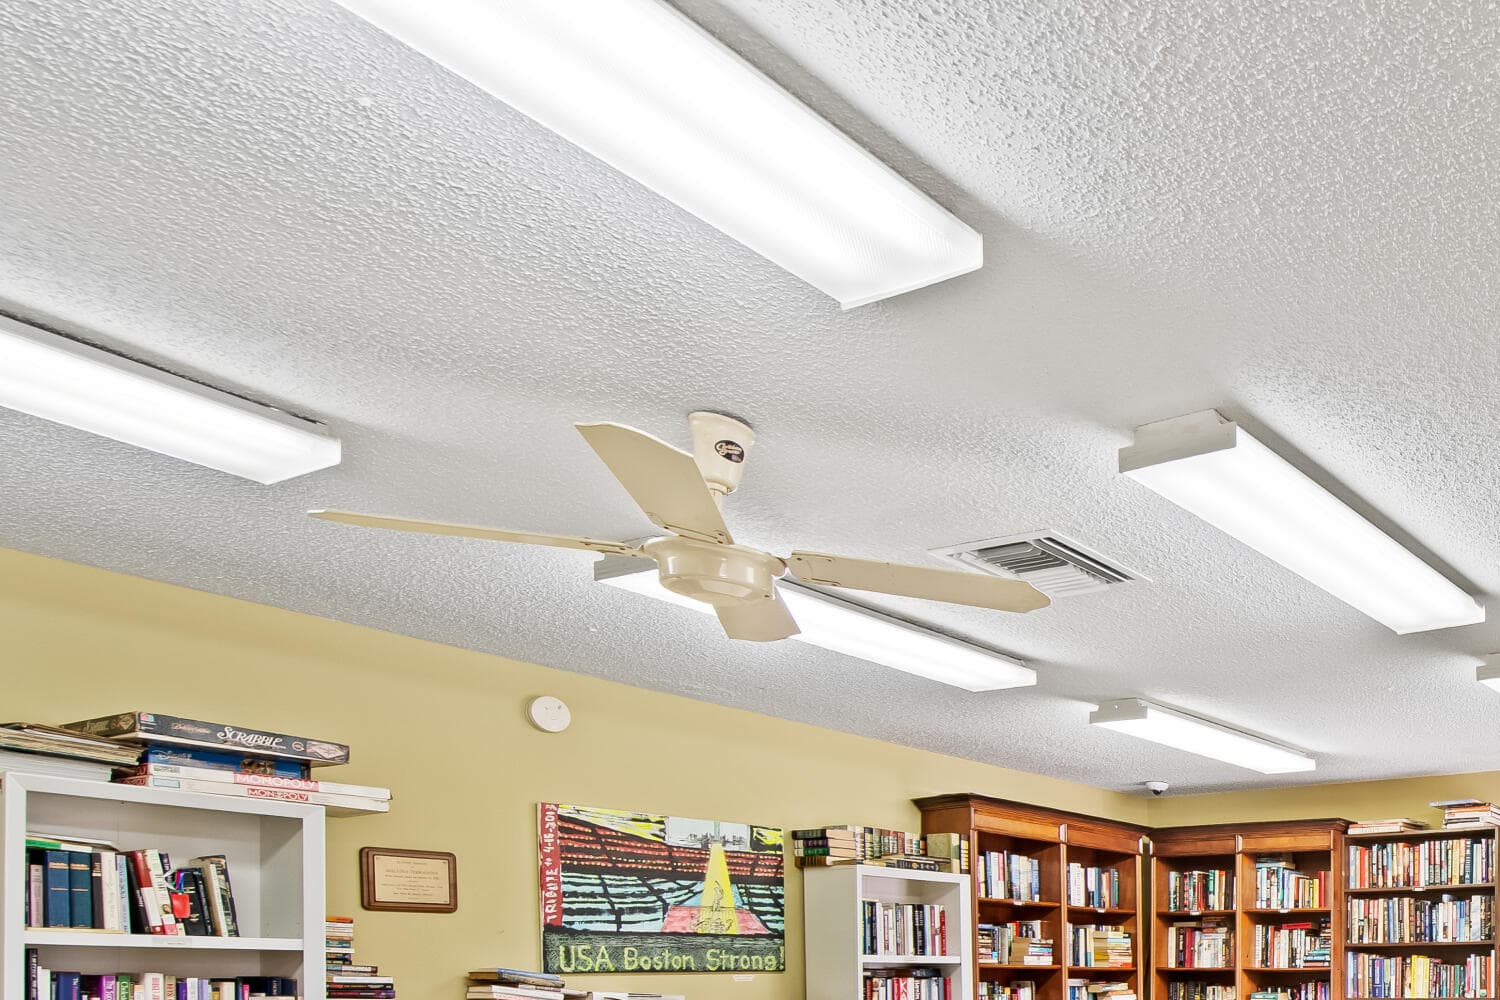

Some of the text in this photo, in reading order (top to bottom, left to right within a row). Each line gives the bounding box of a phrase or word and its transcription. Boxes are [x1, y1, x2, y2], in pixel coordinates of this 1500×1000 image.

[217, 726, 283, 747] SCRABBLE
[236, 774, 316, 790] MONOPOLY
[248, 789, 308, 800] MONOPOLY
[544, 867, 558, 921] TRIBUTE
[558, 945, 785, 972] USA Boston Strong!
